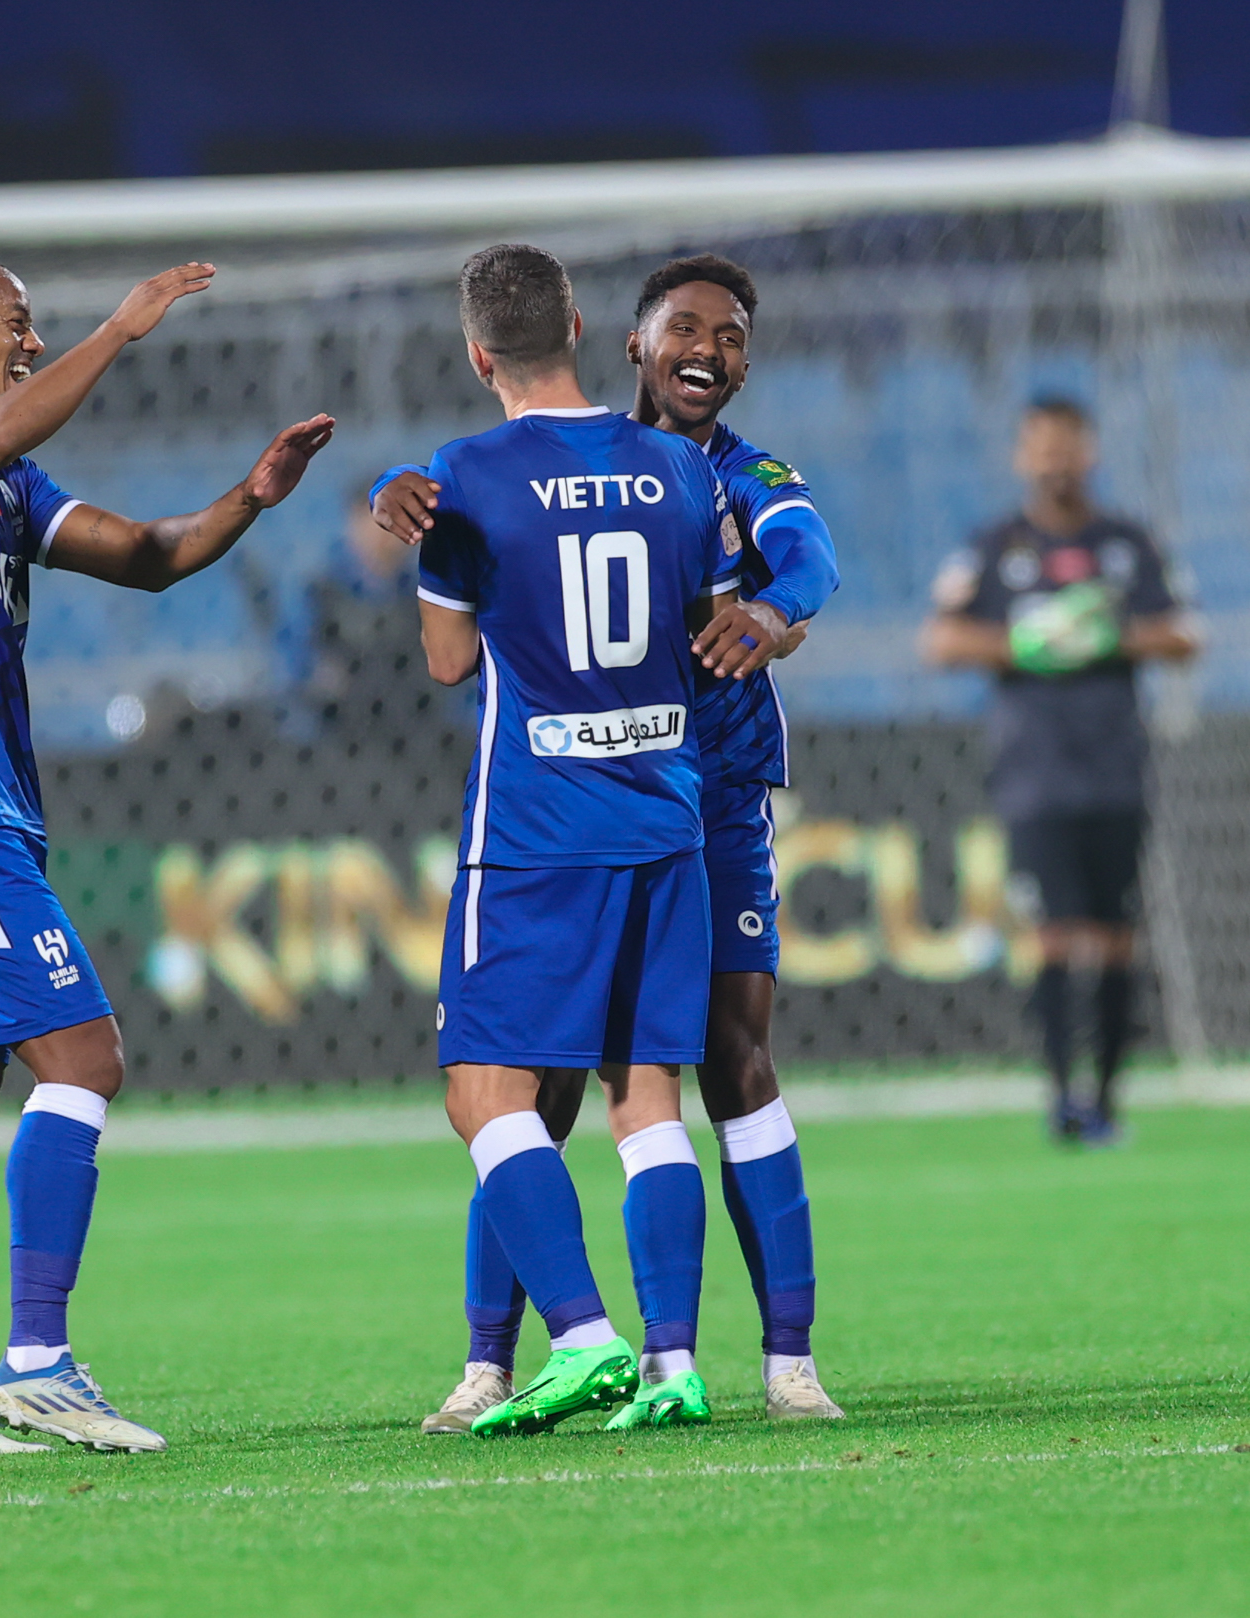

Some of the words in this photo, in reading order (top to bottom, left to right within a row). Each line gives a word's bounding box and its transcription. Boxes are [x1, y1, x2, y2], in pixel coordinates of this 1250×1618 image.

[529, 474, 665, 510] VIETTO
[557, 530, 649, 672] 10
[577, 711, 680, 749] التعاونية
[153, 842, 458, 1025] KIN
[774, 816, 1046, 986] CU
